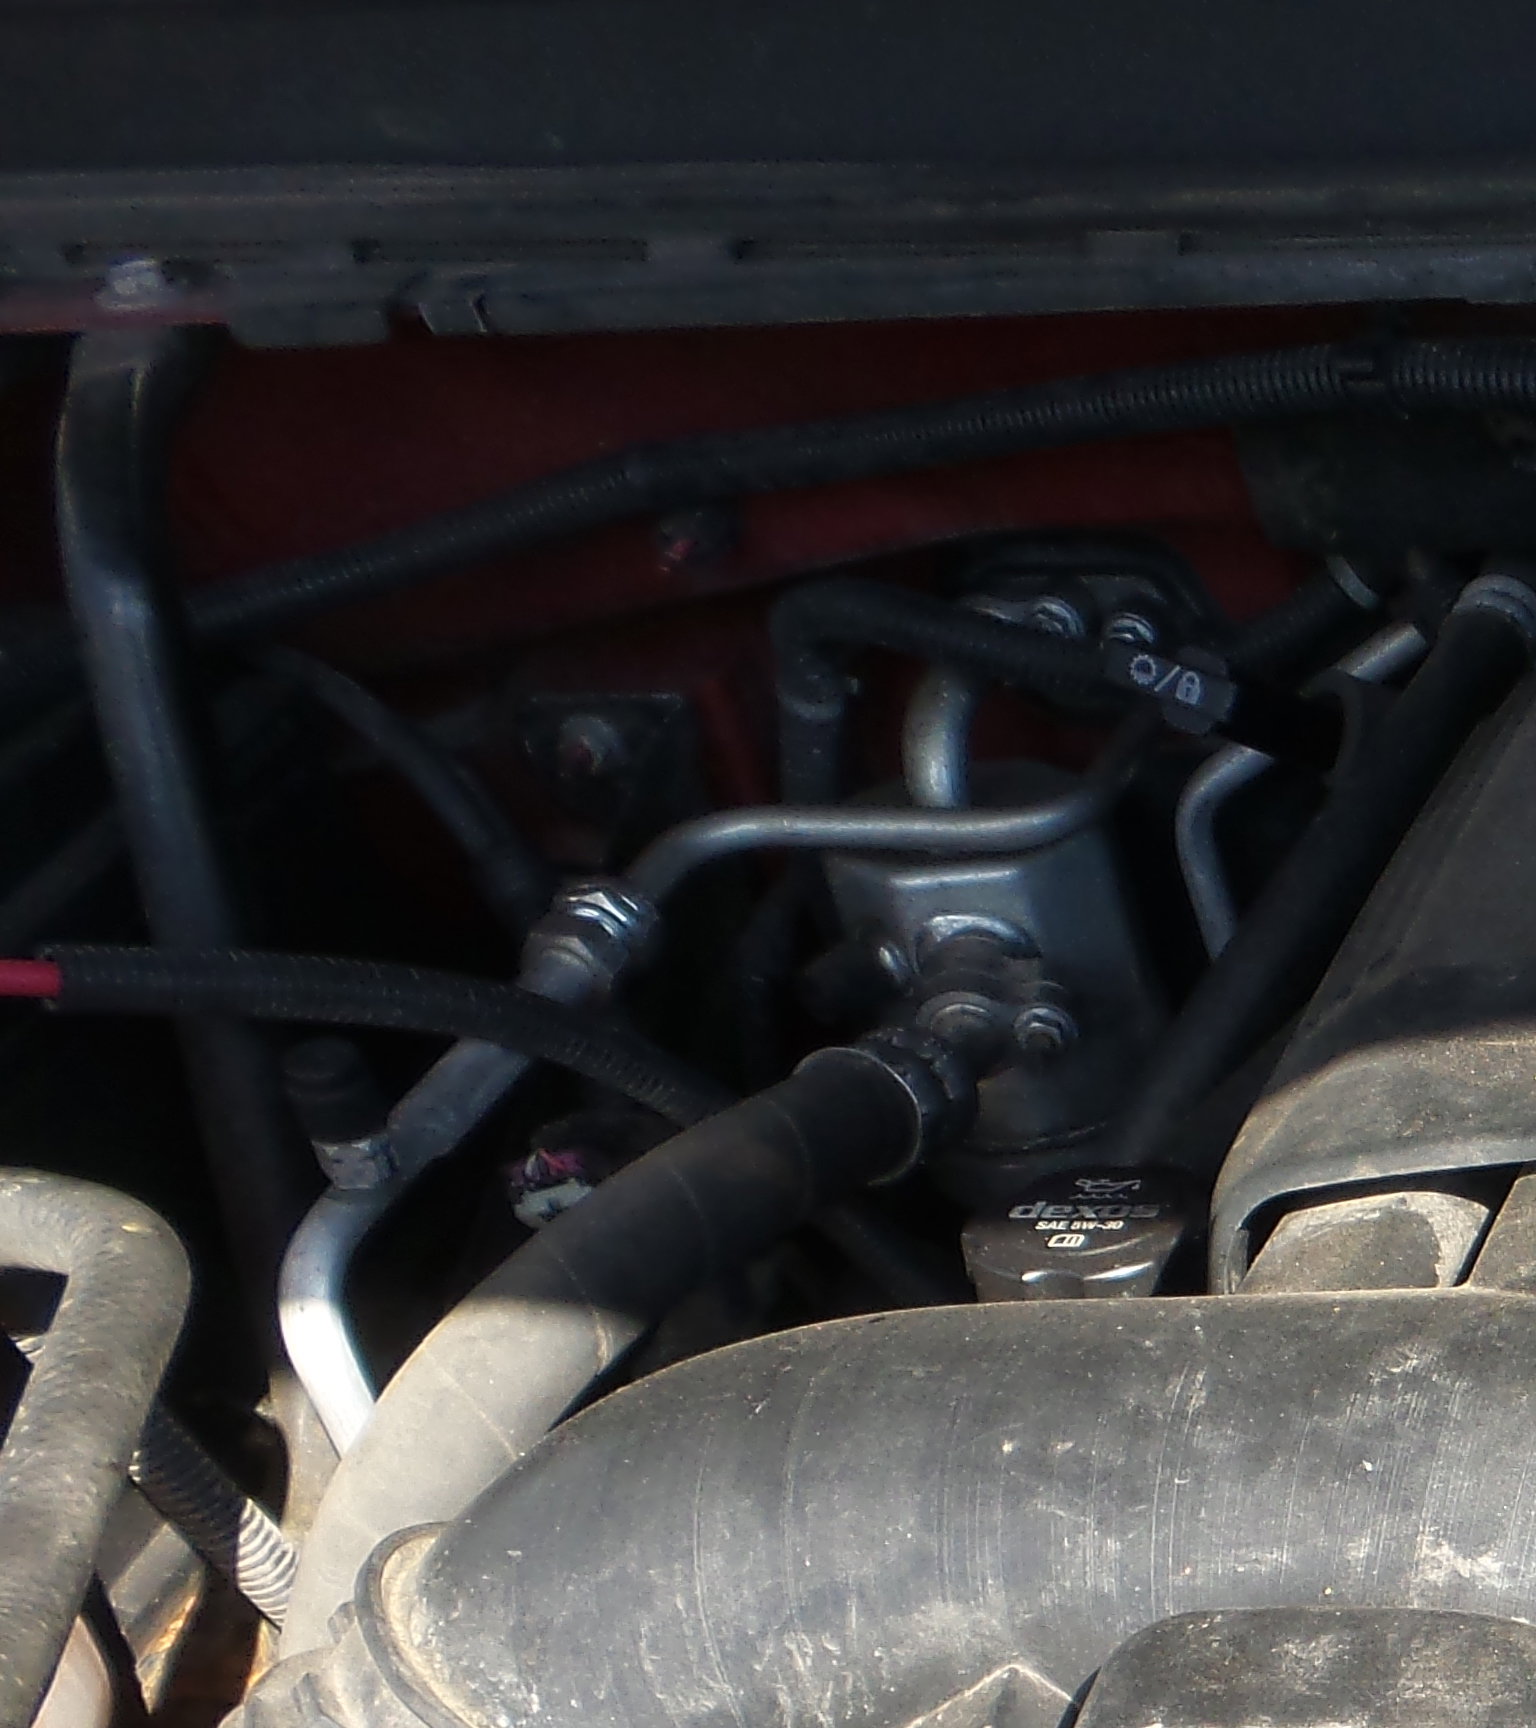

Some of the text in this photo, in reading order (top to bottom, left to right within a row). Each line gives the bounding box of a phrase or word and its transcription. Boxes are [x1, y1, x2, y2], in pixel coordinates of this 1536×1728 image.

[1008, 1201, 1160, 1218] dexos
[1035, 1220, 1125, 1230] SAE 5W-30
